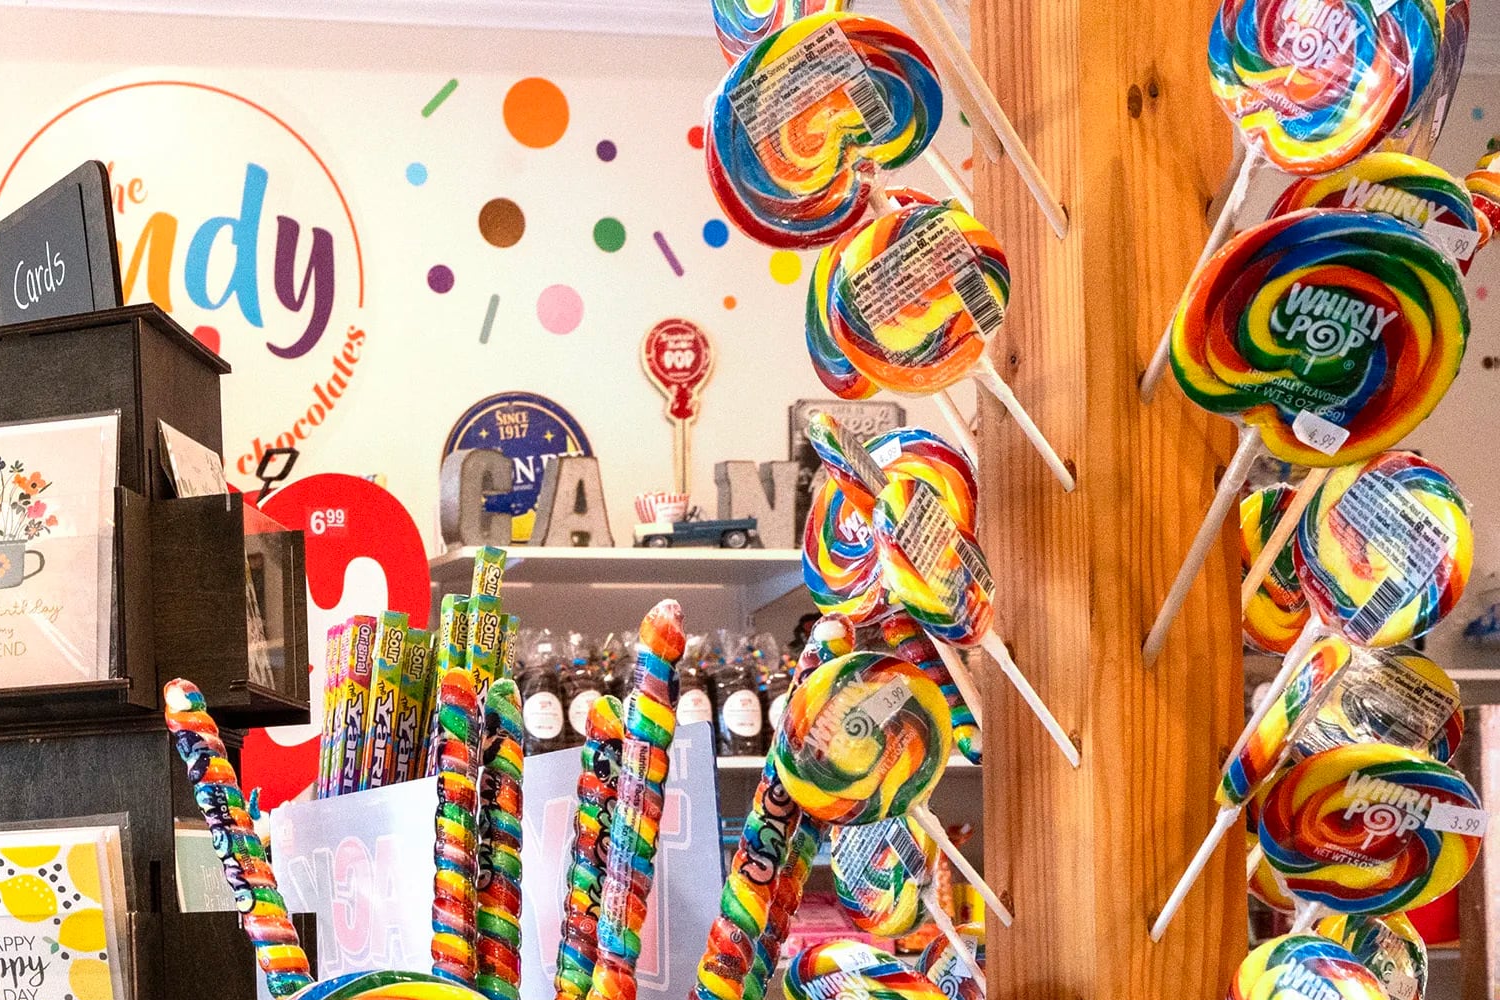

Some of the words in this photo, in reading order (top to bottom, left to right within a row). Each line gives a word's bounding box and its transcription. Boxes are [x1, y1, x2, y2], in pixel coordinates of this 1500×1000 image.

[1276, 22, 1337, 72] POP
[108, 161, 148, 214] he
[13, 242, 67, 311] Cards
[1284, 282, 1398, 342] WHIRLY
[1286, 314, 1365, 361] POP
[237, 324, 368, 478] chocolates
[1235, 380, 1261, 396] NET
[1263, 387, 1284, 401] WT
[1294, 398, 1313, 411] OZ
[1300, 382, 1349, 407] FLAVORED
[495, 410, 528, 426] SINCE
[499, 423, 529, 441] 1917
[355, 623, 373, 675] Original
[387, 627, 404, 664] Sour
[480, 612, 498, 650] Sour
[408, 645, 426, 680] Sour
[347, 682, 357, 701] The
[376, 680, 386, 699] The
[342, 690, 366, 787] YaR
[372, 689, 397, 789] YaR
[1344, 799, 1420, 843] POP
[1450, 815, 1481, 833] 3.99
